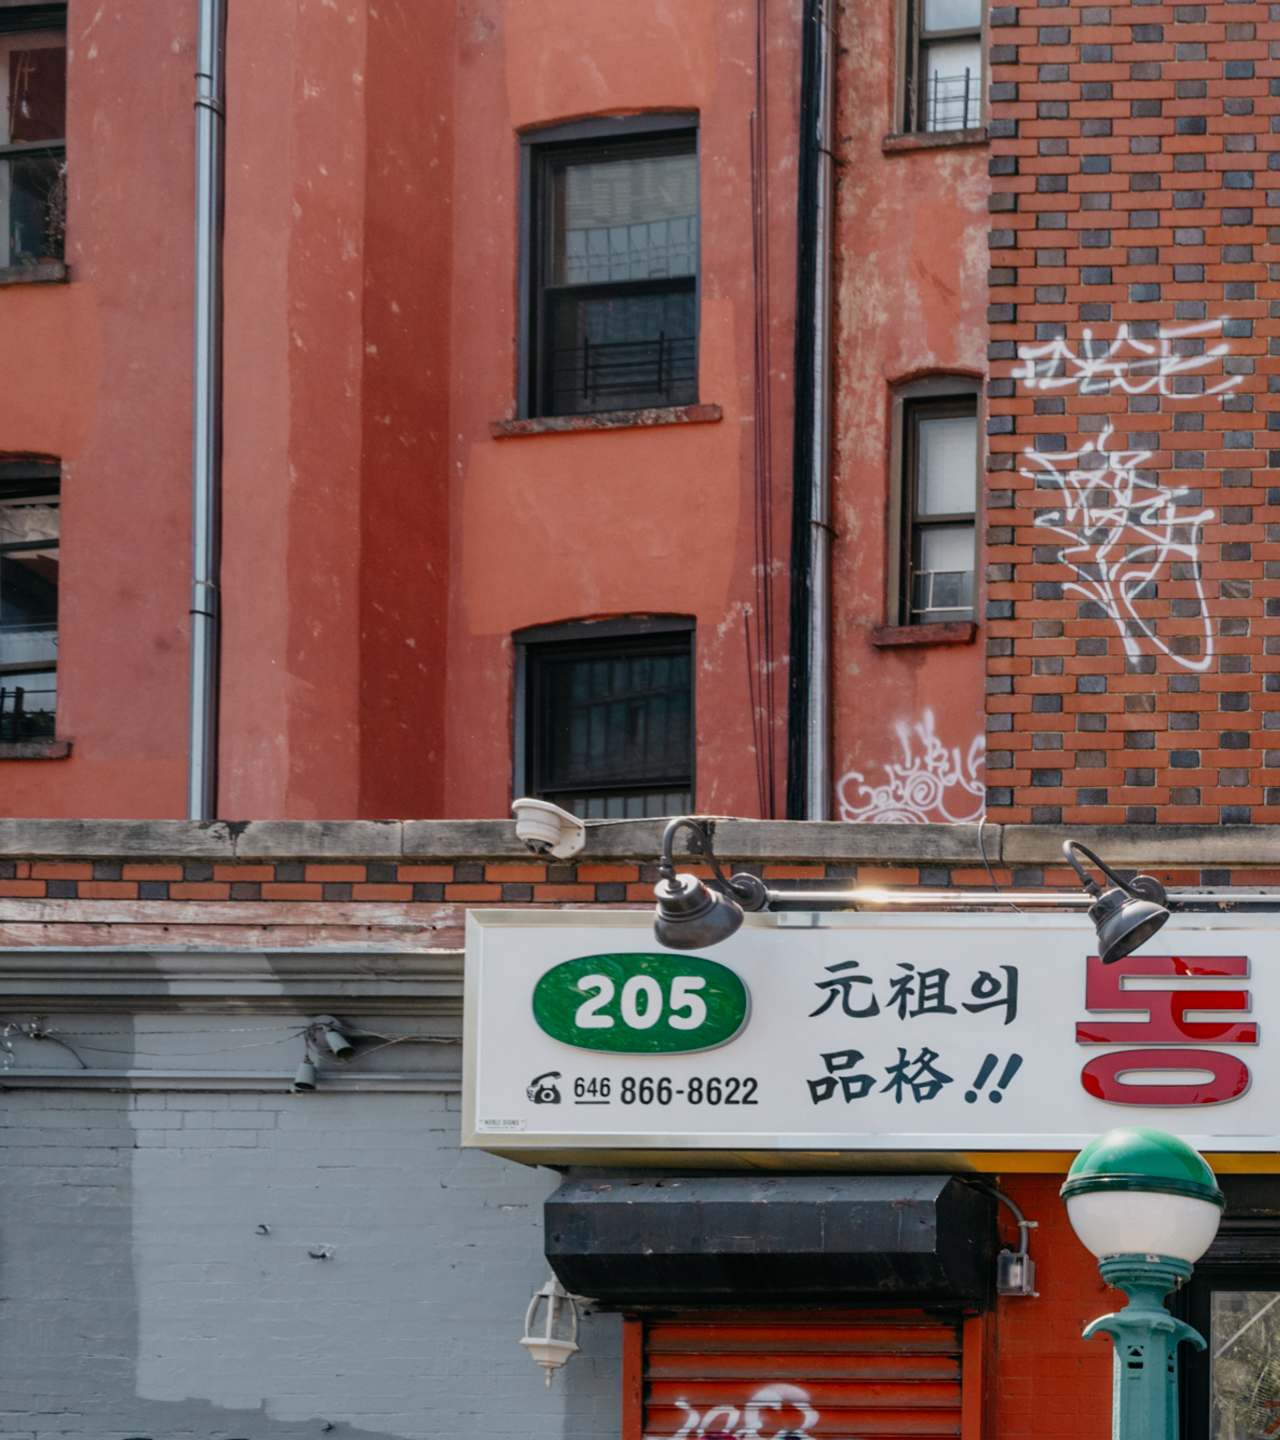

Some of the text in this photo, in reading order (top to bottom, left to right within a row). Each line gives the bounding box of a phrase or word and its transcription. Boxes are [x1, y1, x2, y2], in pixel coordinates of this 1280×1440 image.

[575, 975, 709, 1031] 205
[808, 960, 1020, 1026] 元祖의
[574, 1076, 759, 1107] 646 866-8622
